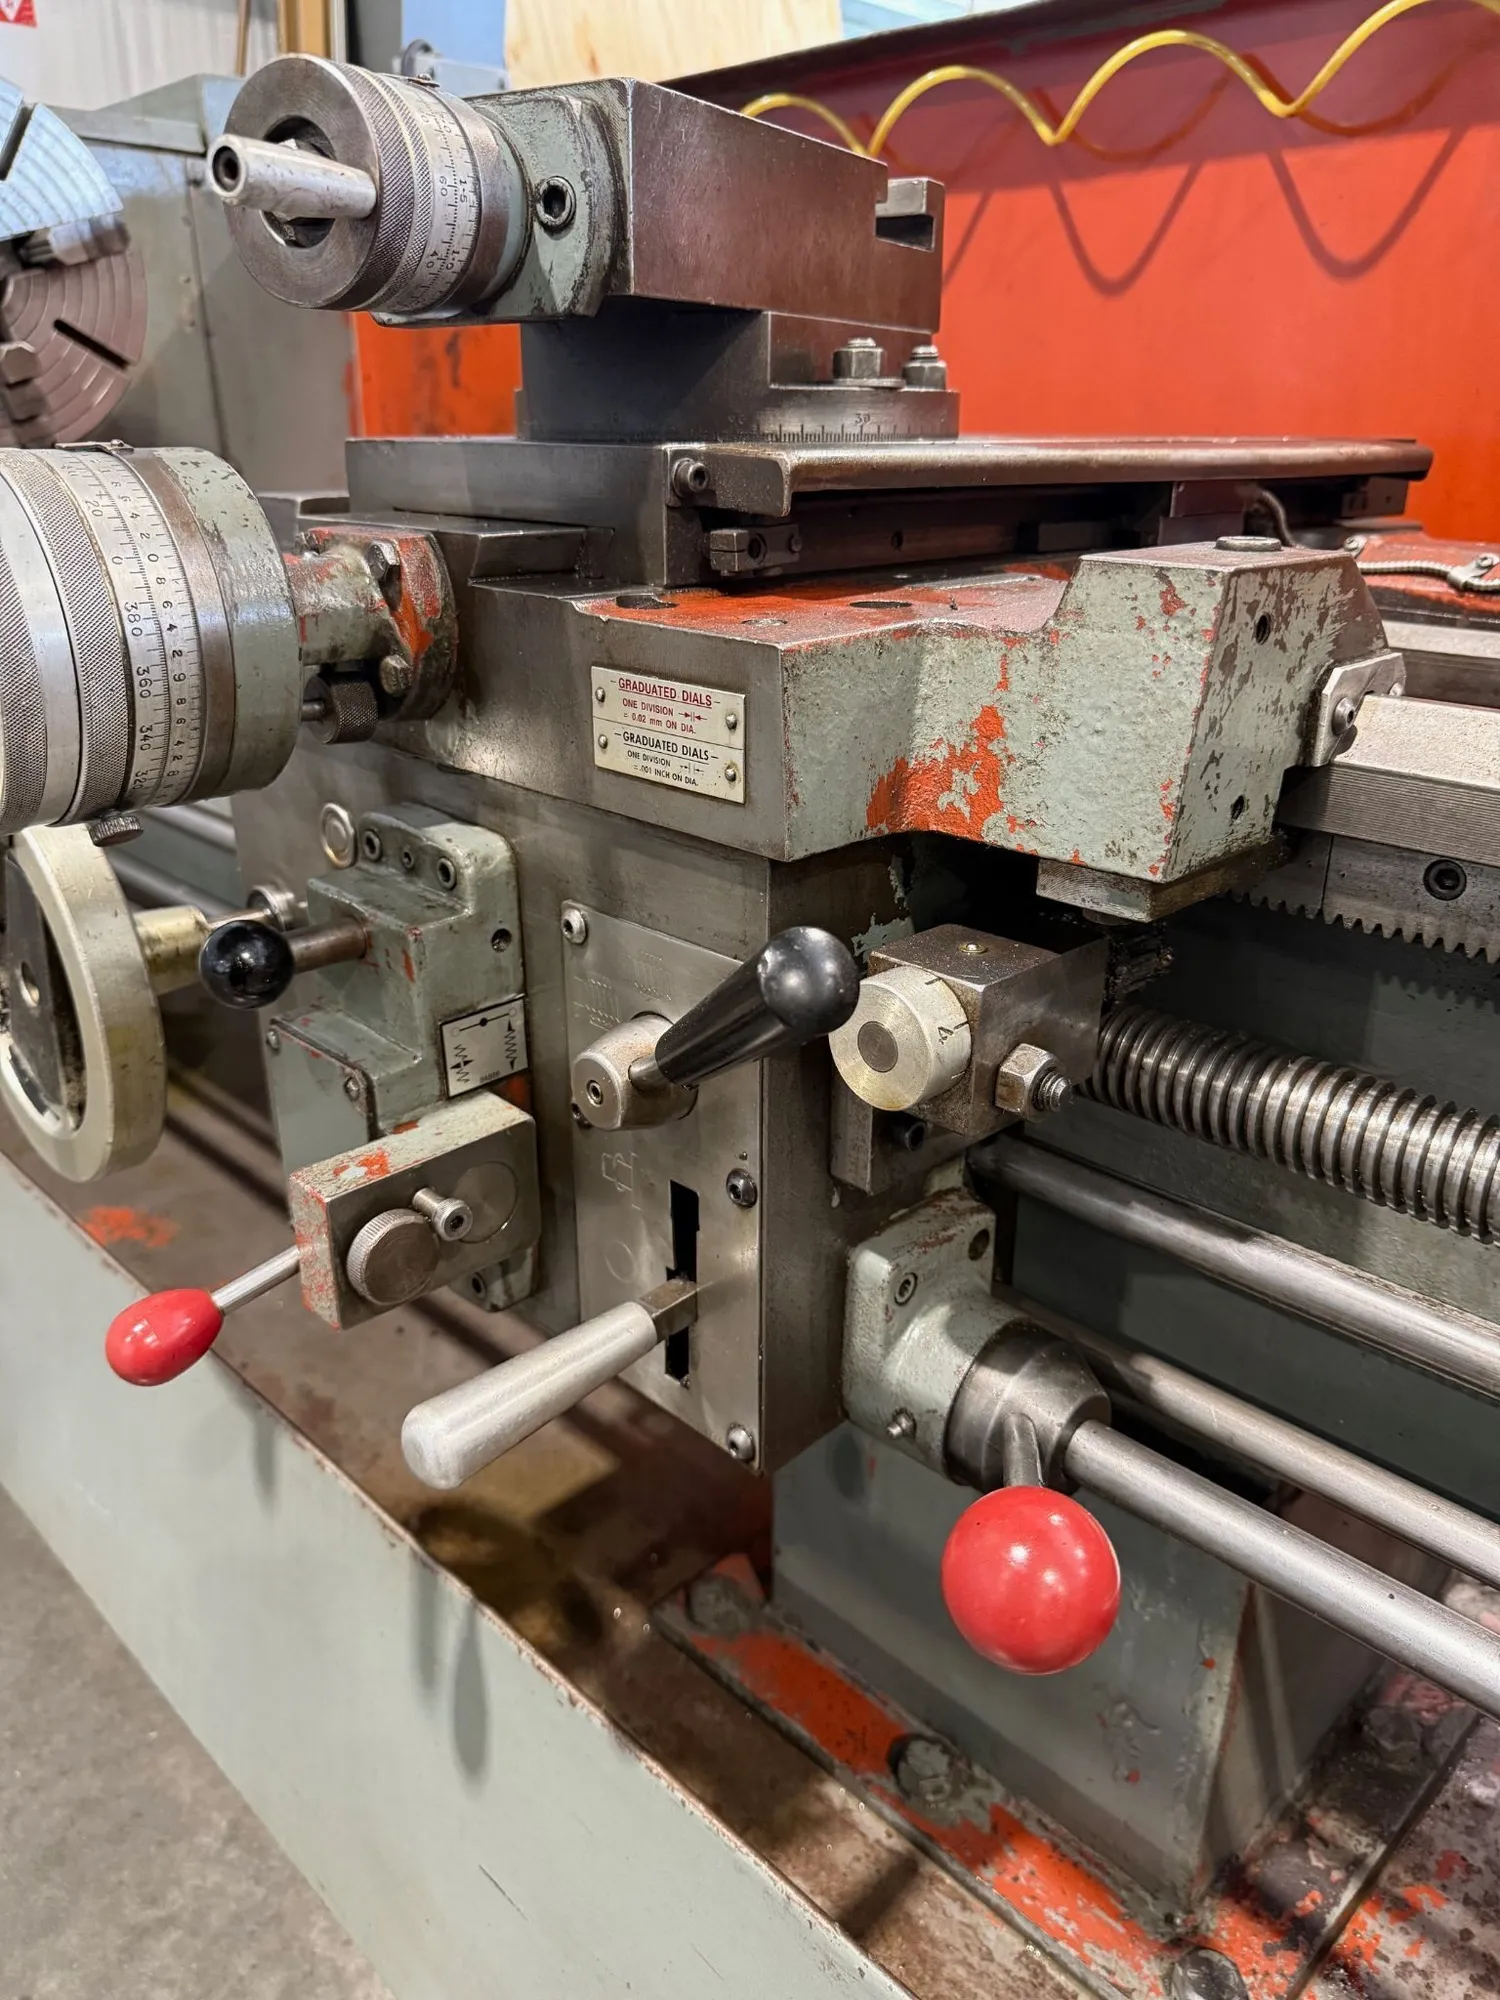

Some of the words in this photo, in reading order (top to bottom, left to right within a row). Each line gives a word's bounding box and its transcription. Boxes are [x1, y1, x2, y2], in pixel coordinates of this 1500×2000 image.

[440, 176, 448, 197] 60
[426, 250, 438, 269] 40
[855, 413, 870, 424] 30
[85, 500, 103, 517] 20
[111, 556, 123, 565] 0
[148, 553, 159, 563] 0
[156, 577, 166, 585] 8
[162, 600, 173, 609] 6
[124, 601, 143, 637] 380
[166, 623, 178, 632] 4
[172, 649, 183, 658] 2
[136, 666, 152, 699] 360
[173, 672, 187, 682] 9
[618, 677, 677, 699] GRADUATED
[682, 690, 713, 707] DIALS
[176, 697, 187, 706] 8
[622, 698, 638, 709] ONE
[641, 703, 674, 716] DIVISION
[176, 717, 187, 725] 6
[632, 712, 647, 724] 0.02
[650, 718, 663, 727] mm
[666, 720, 678, 730] ON
[681, 723, 697, 735] DIA.
[140, 725, 153, 751] 340
[623, 731, 679, 753] GRADUATED
[682, 744, 709, 761] DIALS
[627, 750, 640, 760] ONE
[643, 753, 671, 767] DIVISION
[132, 770, 148, 790] 320
[654, 768, 670, 780] INCH
[672, 772, 683, 782] ON
[685, 775, 699, 787] DIA.
